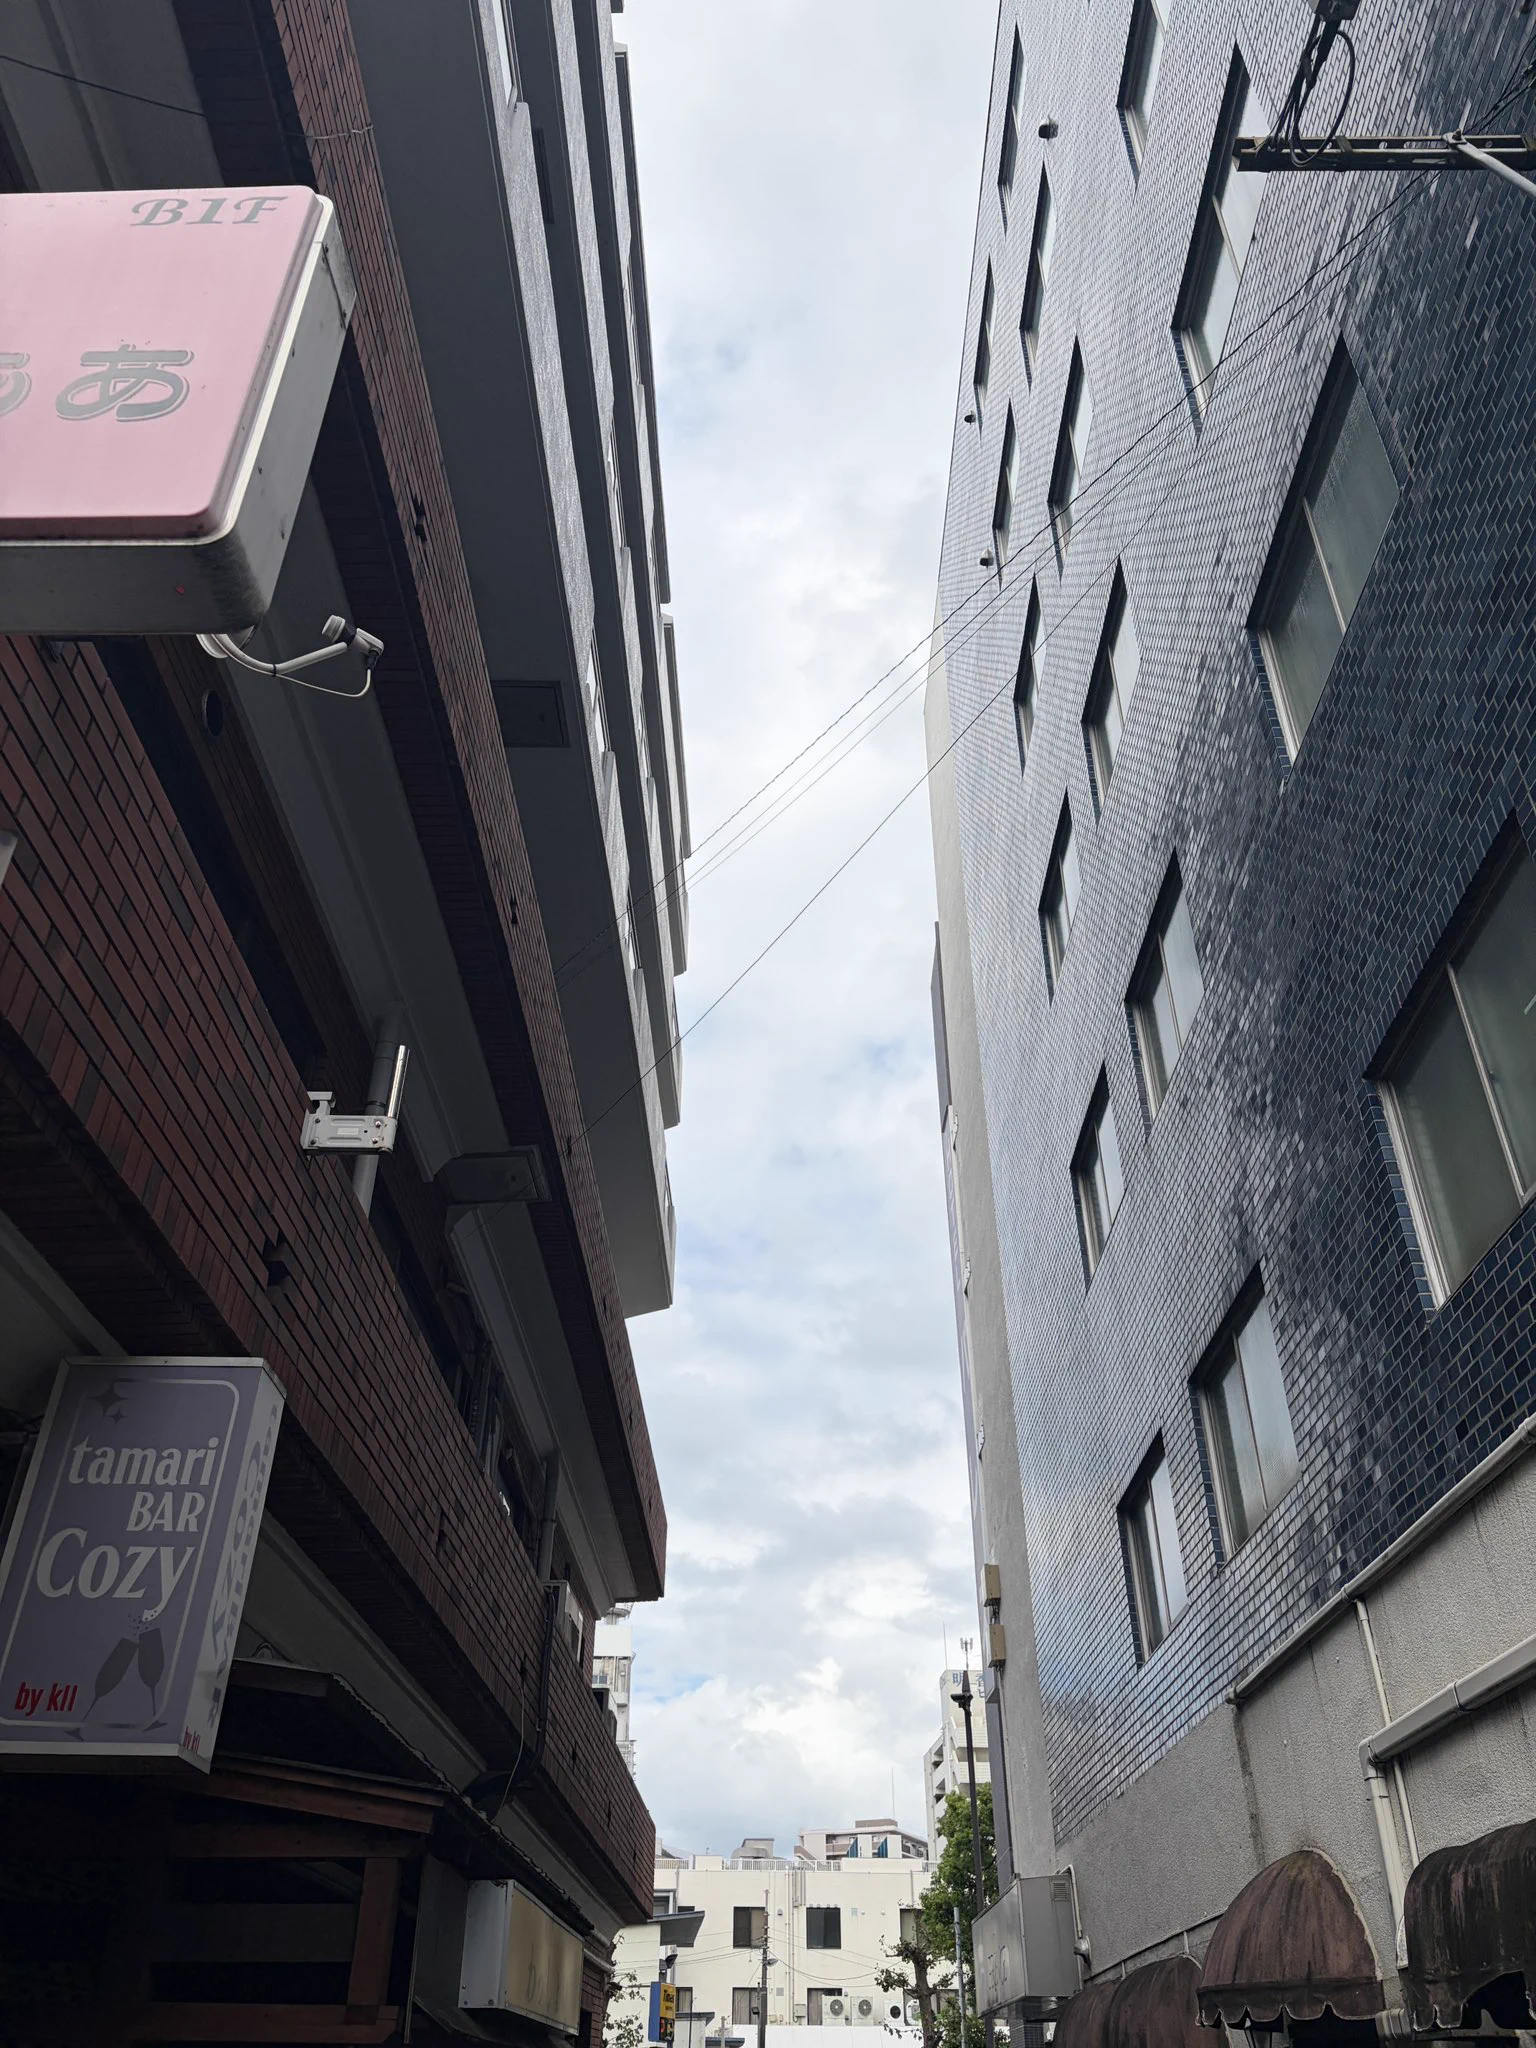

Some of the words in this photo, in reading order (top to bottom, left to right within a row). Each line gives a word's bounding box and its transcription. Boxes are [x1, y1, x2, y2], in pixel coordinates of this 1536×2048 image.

[130, 196, 288, 226] B1F
[0, 344, 194, 422] あ
[68, 1435, 219, 1486] tamari
[126, 1491, 206, 1532] BAR
[36, 1527, 195, 1622] Cozy
[14, 1681, 44, 1717] by
